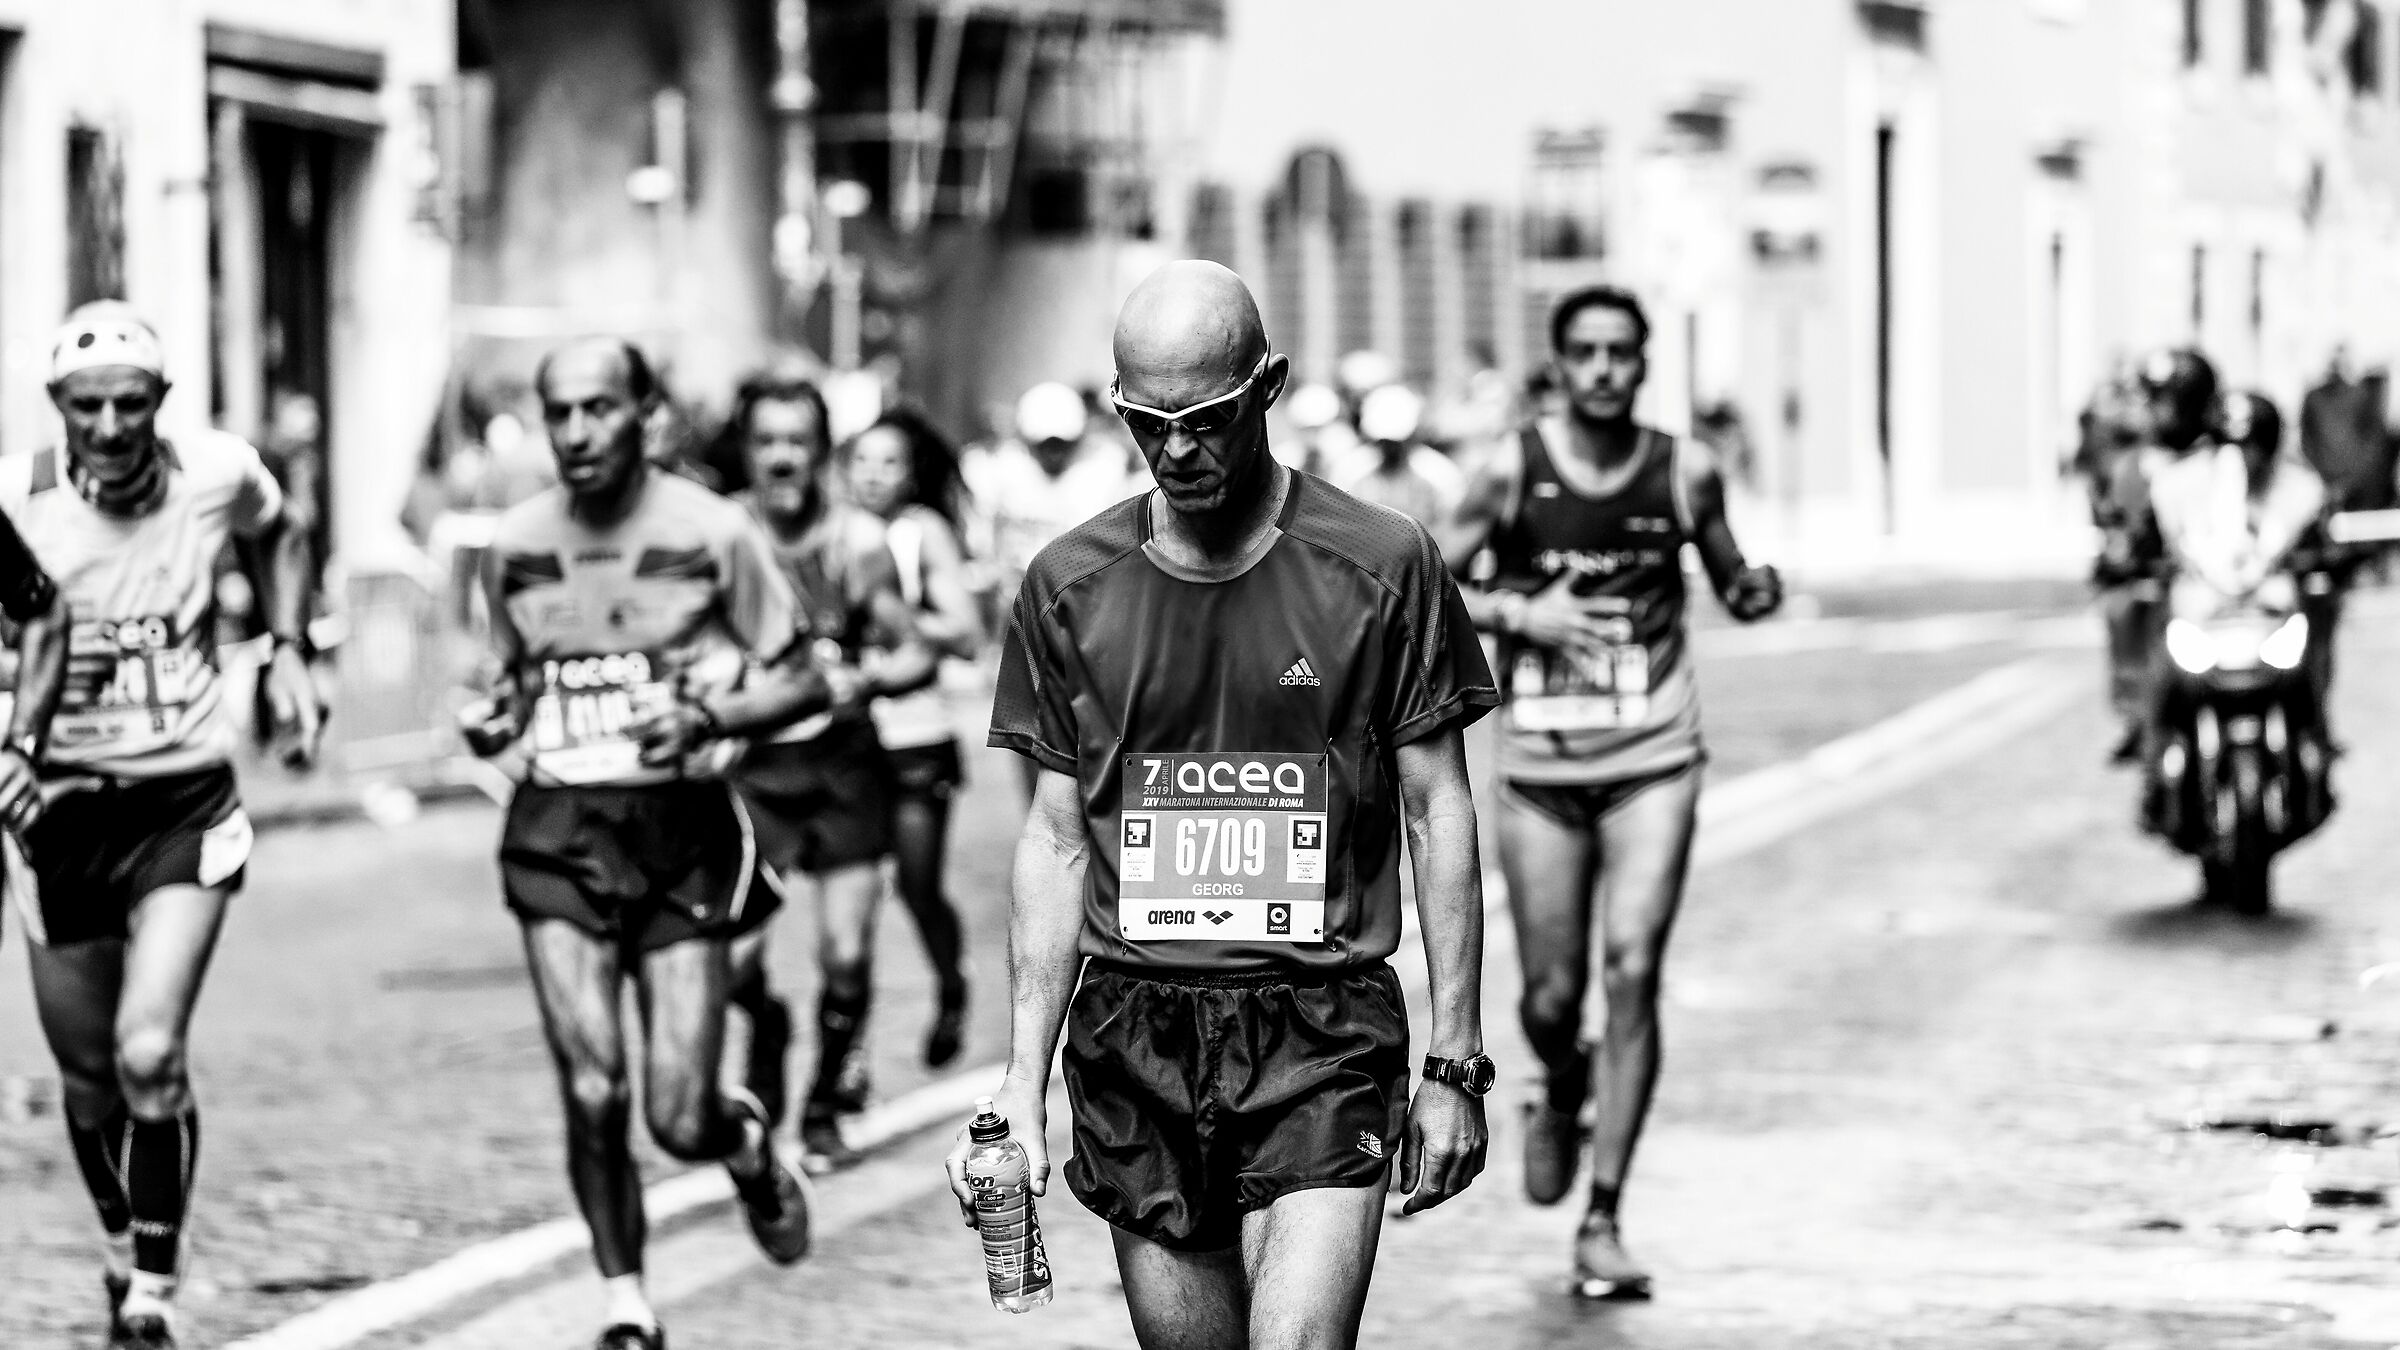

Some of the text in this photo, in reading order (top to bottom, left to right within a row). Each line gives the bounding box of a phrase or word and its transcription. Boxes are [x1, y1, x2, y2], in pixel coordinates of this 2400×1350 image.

[1279, 675, 1321, 687] adidas
[1142, 759, 1162, 786] 7
[1162, 759, 1170, 786] APRILE
[1177, 761, 1305, 794] acea
[1142, 785, 1169, 795] 2019
[1142, 797, 1304, 808] XXV MARATONA INTERNAZIONALE DI ROMA
[1175, 817, 1266, 876] 6709
[1192, 883, 1244, 896] GEORG
[1147, 909, 1195, 925] arena
[967, 1171, 995, 1188] ion
